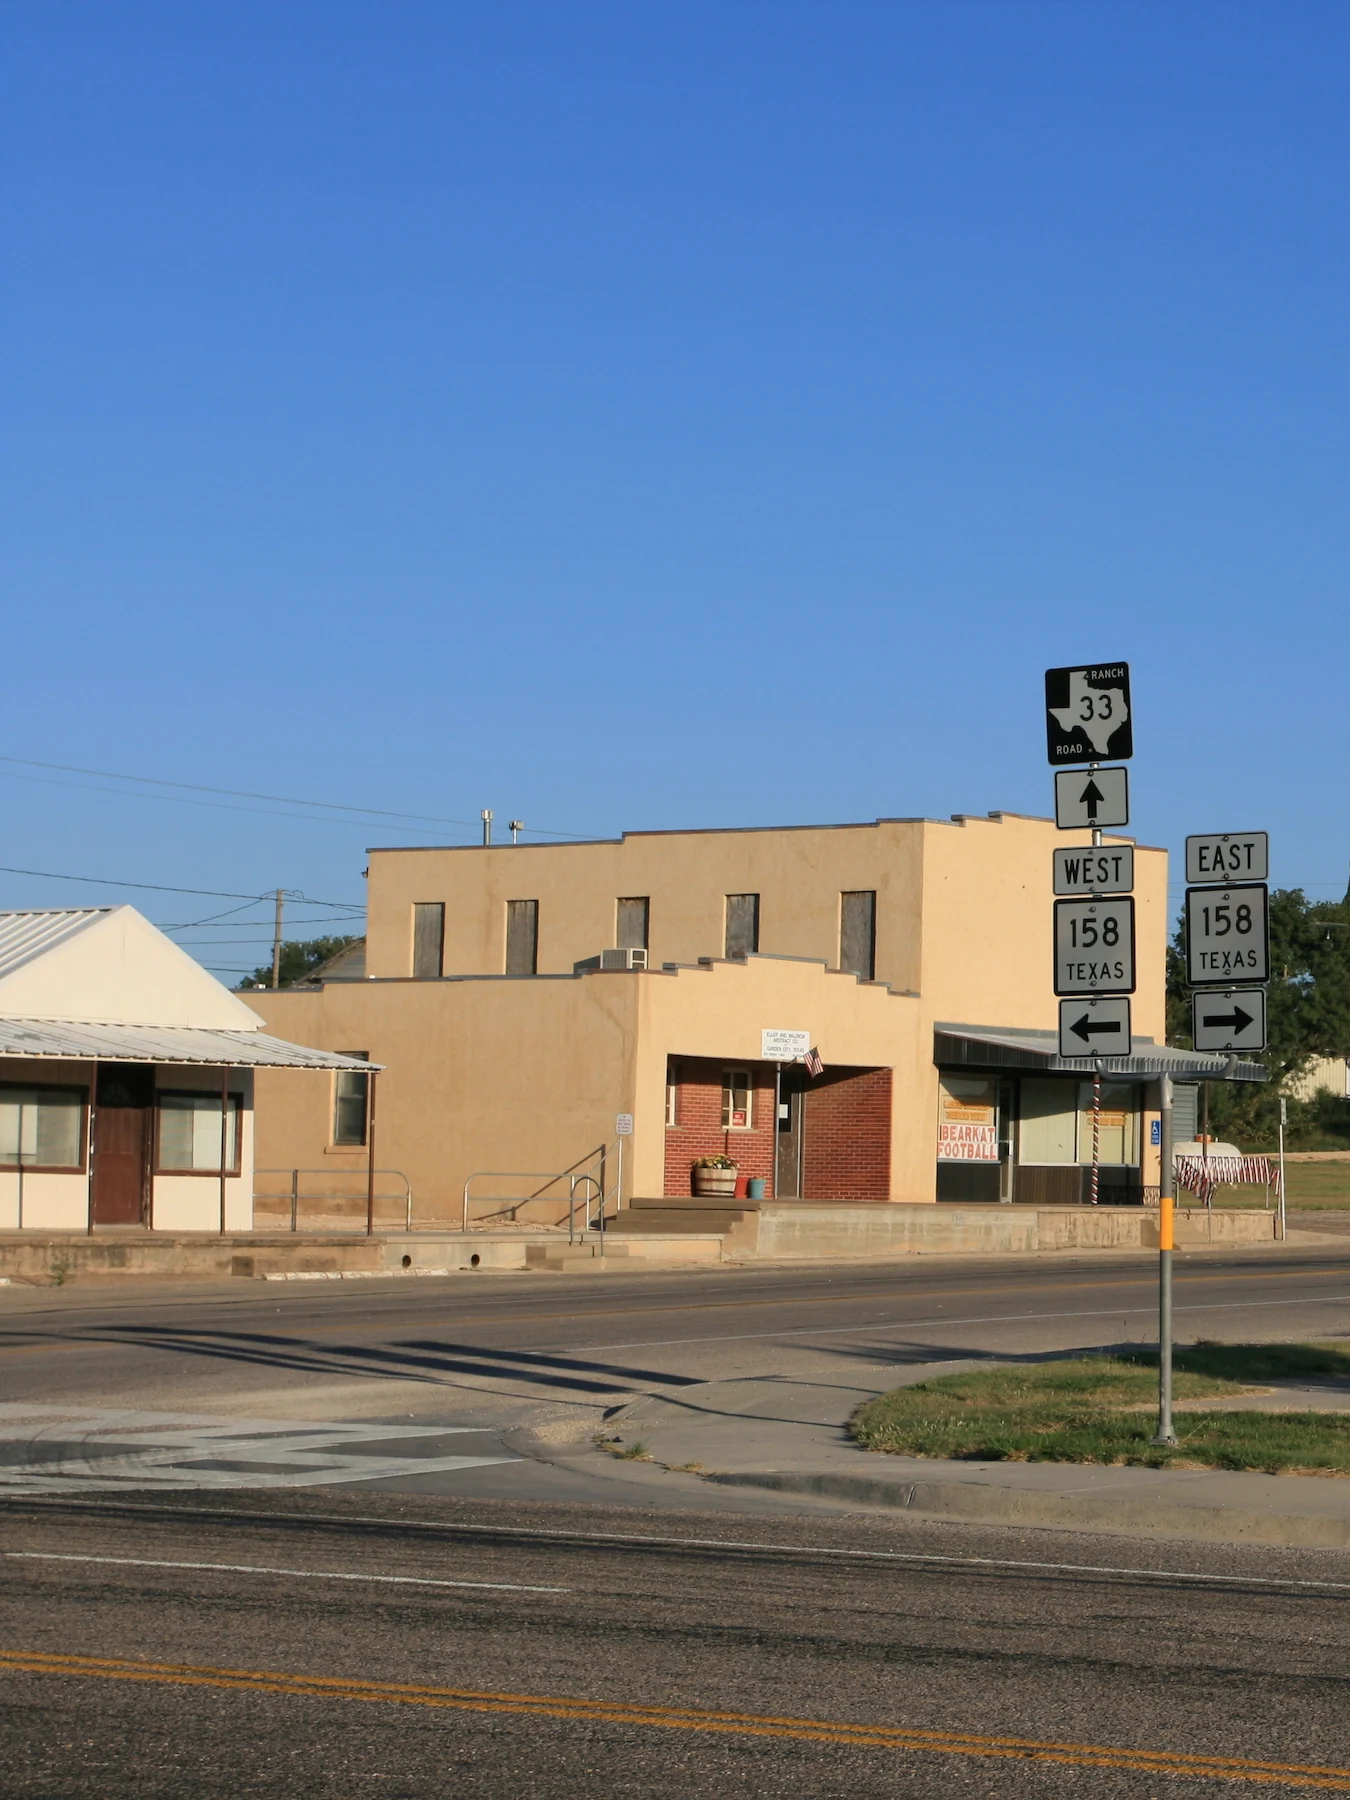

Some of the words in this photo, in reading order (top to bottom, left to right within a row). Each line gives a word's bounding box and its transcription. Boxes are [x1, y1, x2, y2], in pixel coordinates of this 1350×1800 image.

[1091, 668, 1124, 680] RANCH
[1079, 694, 1113, 721] 33
[1056, 744, 1083, 755] ROAD
[1198, 843, 1255, 872] EAST
[1064, 857, 1123, 884] WEST
[1202, 904, 1252, 936] 158
[1070, 916, 1120, 948] 158
[1199, 950, 1257, 970] TEXAS
[1066, 962, 1124, 981] TEXAS
[942, 1125, 995, 1143] BEARKAT
[937, 1142, 997, 1160] FOOTBALL
